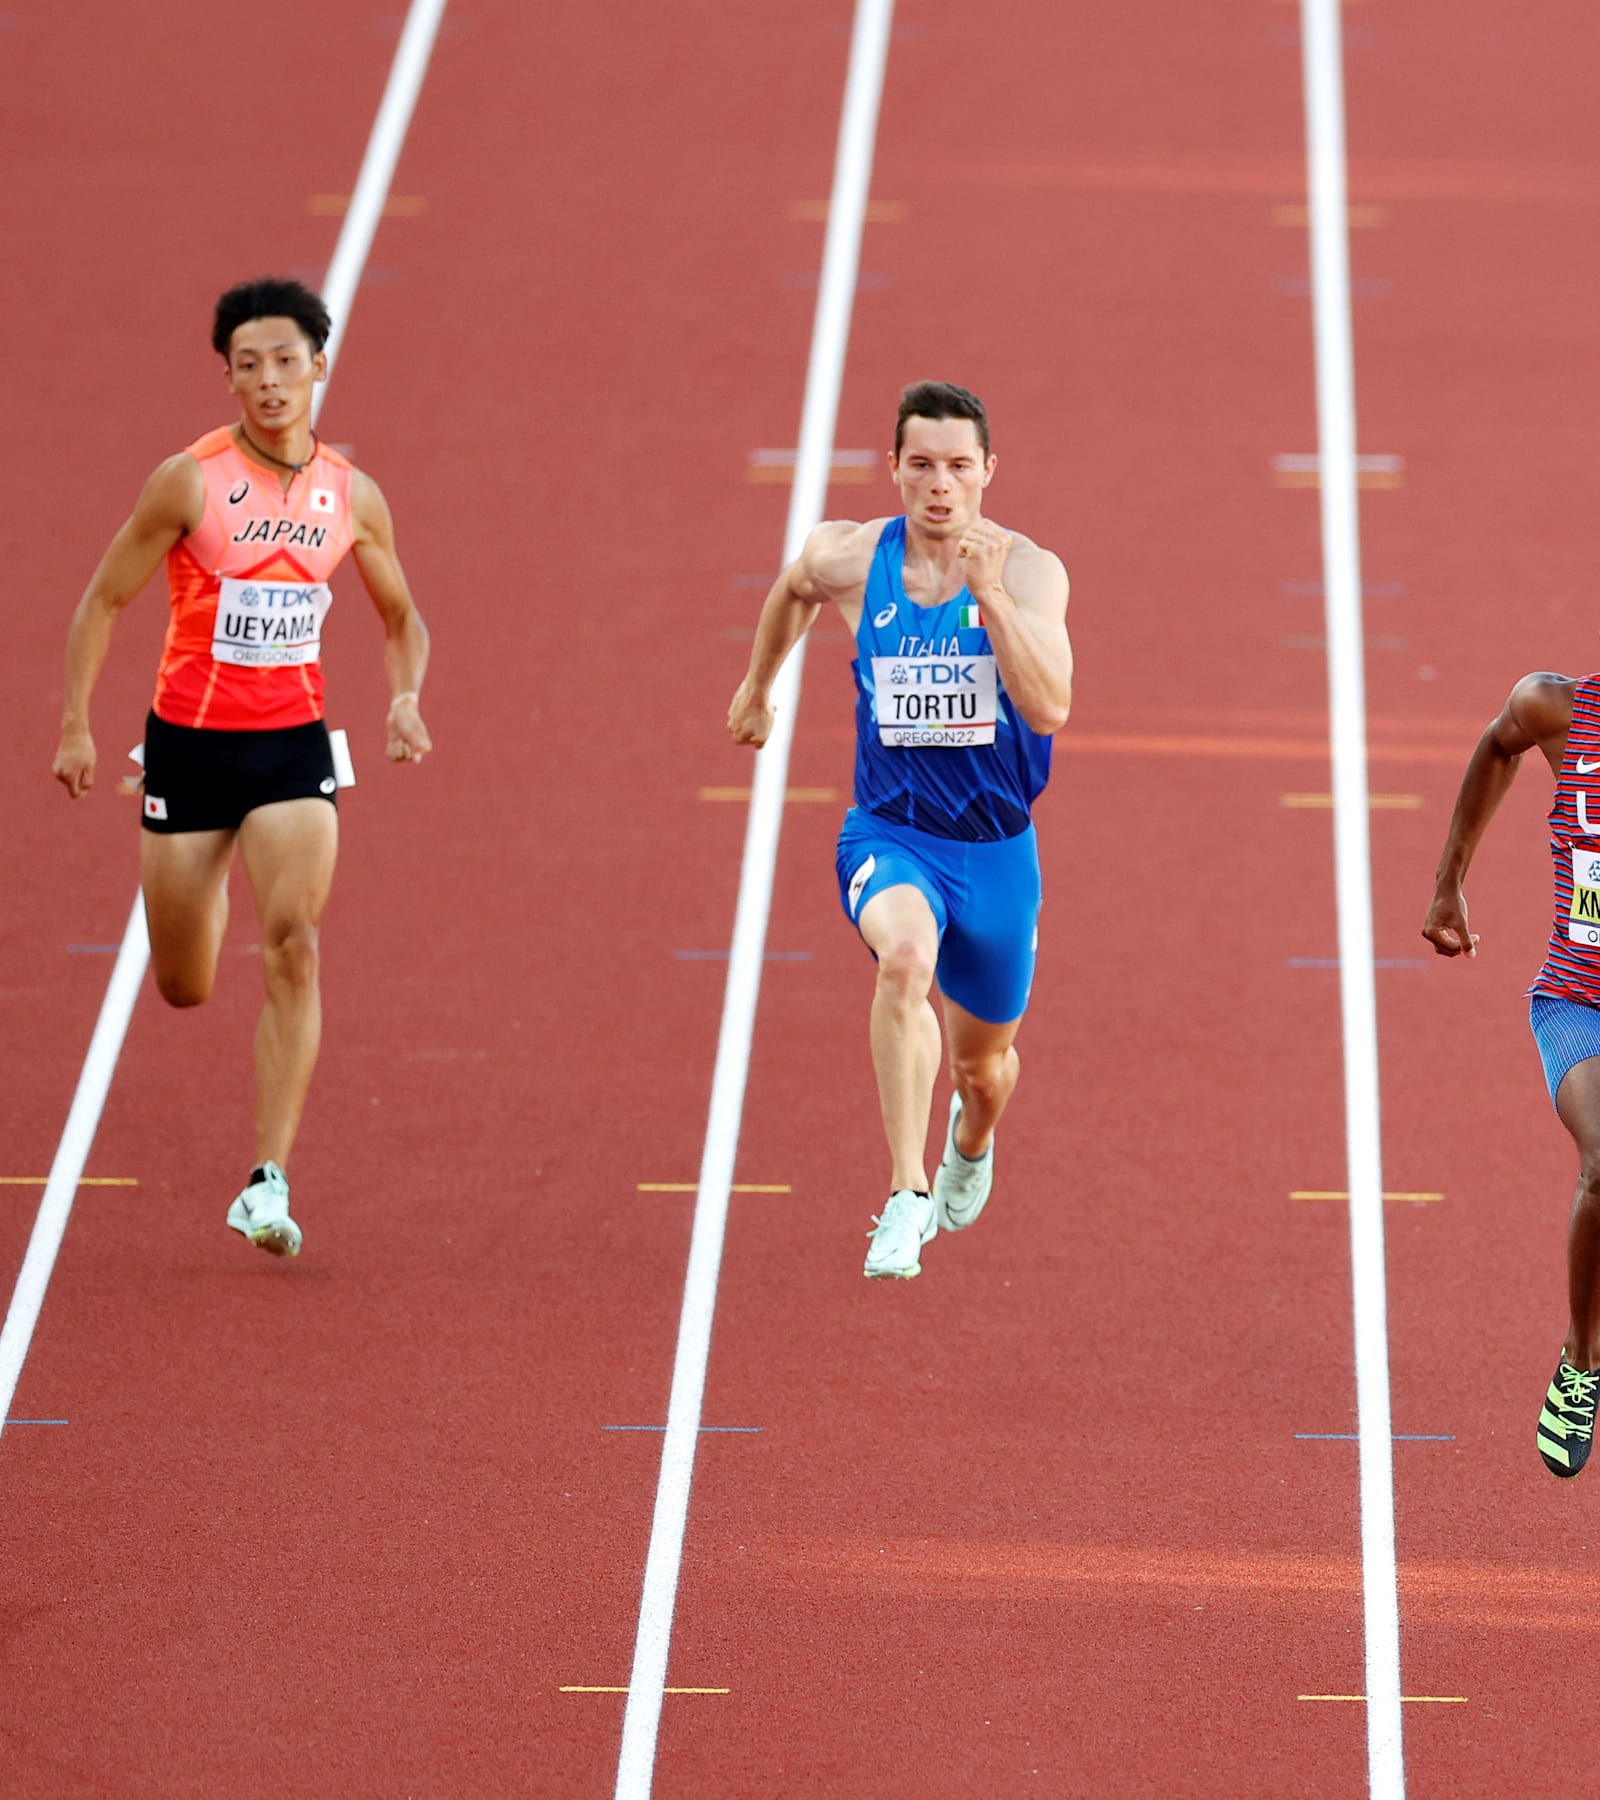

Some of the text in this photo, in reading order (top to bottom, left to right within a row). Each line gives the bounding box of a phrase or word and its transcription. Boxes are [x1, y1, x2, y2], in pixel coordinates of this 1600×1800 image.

[232, 519, 327, 548] JAPAN
[261, 587, 320, 608] TDK
[897, 635, 961, 657] ITALIA
[909, 663, 977, 685] TDK
[893, 693, 977, 721] TORTU
[894, 731, 976, 745] OREGON22
